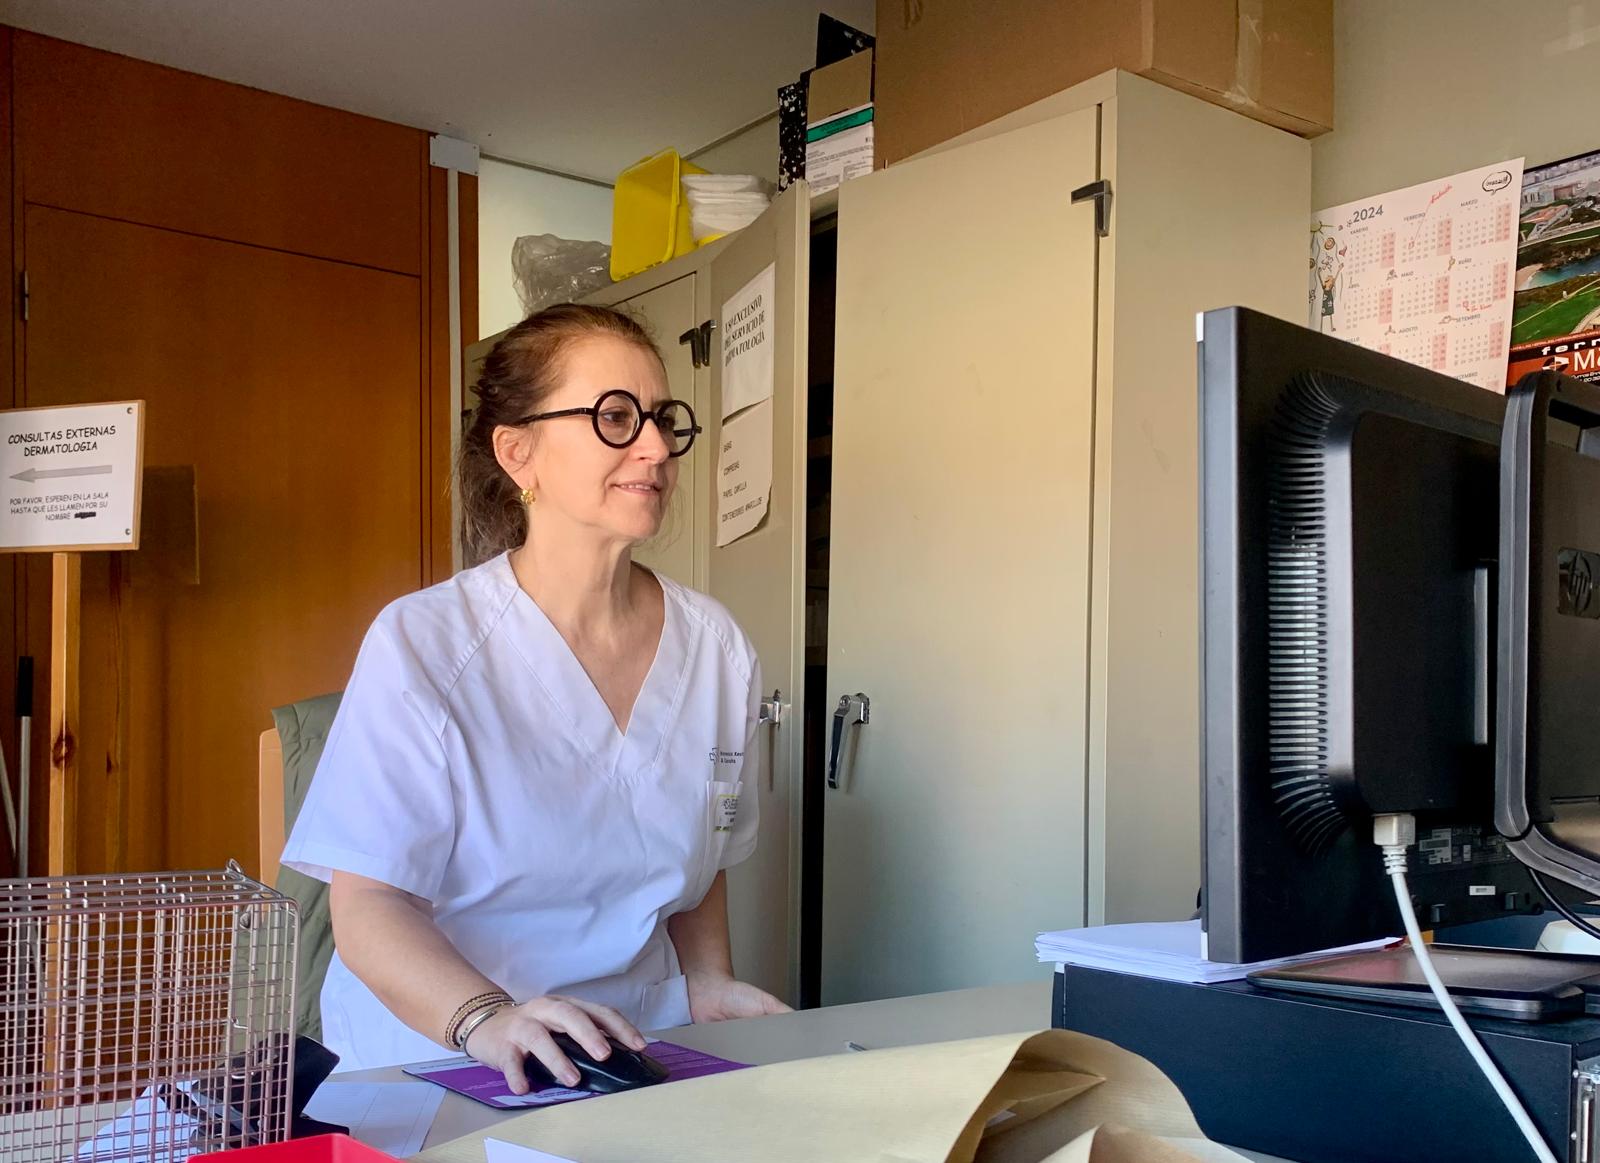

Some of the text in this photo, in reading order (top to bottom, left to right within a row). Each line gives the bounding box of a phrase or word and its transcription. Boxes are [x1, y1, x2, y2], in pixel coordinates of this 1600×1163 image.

[1460, 199, 1478, 207] MARZO
[1353, 204, 1384, 223] 2024
[733, 293, 763, 326] EXCLUSIVO
[731, 316, 758, 341] SERVICIO
[8, 425, 116, 445] CONSULTAS EXTERNAS
[24, 441, 98, 457] DERMATOLOGIA
[10, 497, 21, 506] POR
[45, 494, 72, 503] ESPEREN
[73, 493, 82, 501] EN
[83, 492, 91, 501] LA
[93, 491, 109, 500] SALA
[11, 500, 108, 515] HASTA QUE LES LLAMEN POR SU
[46, 512, 71, 521] NOMBRE
